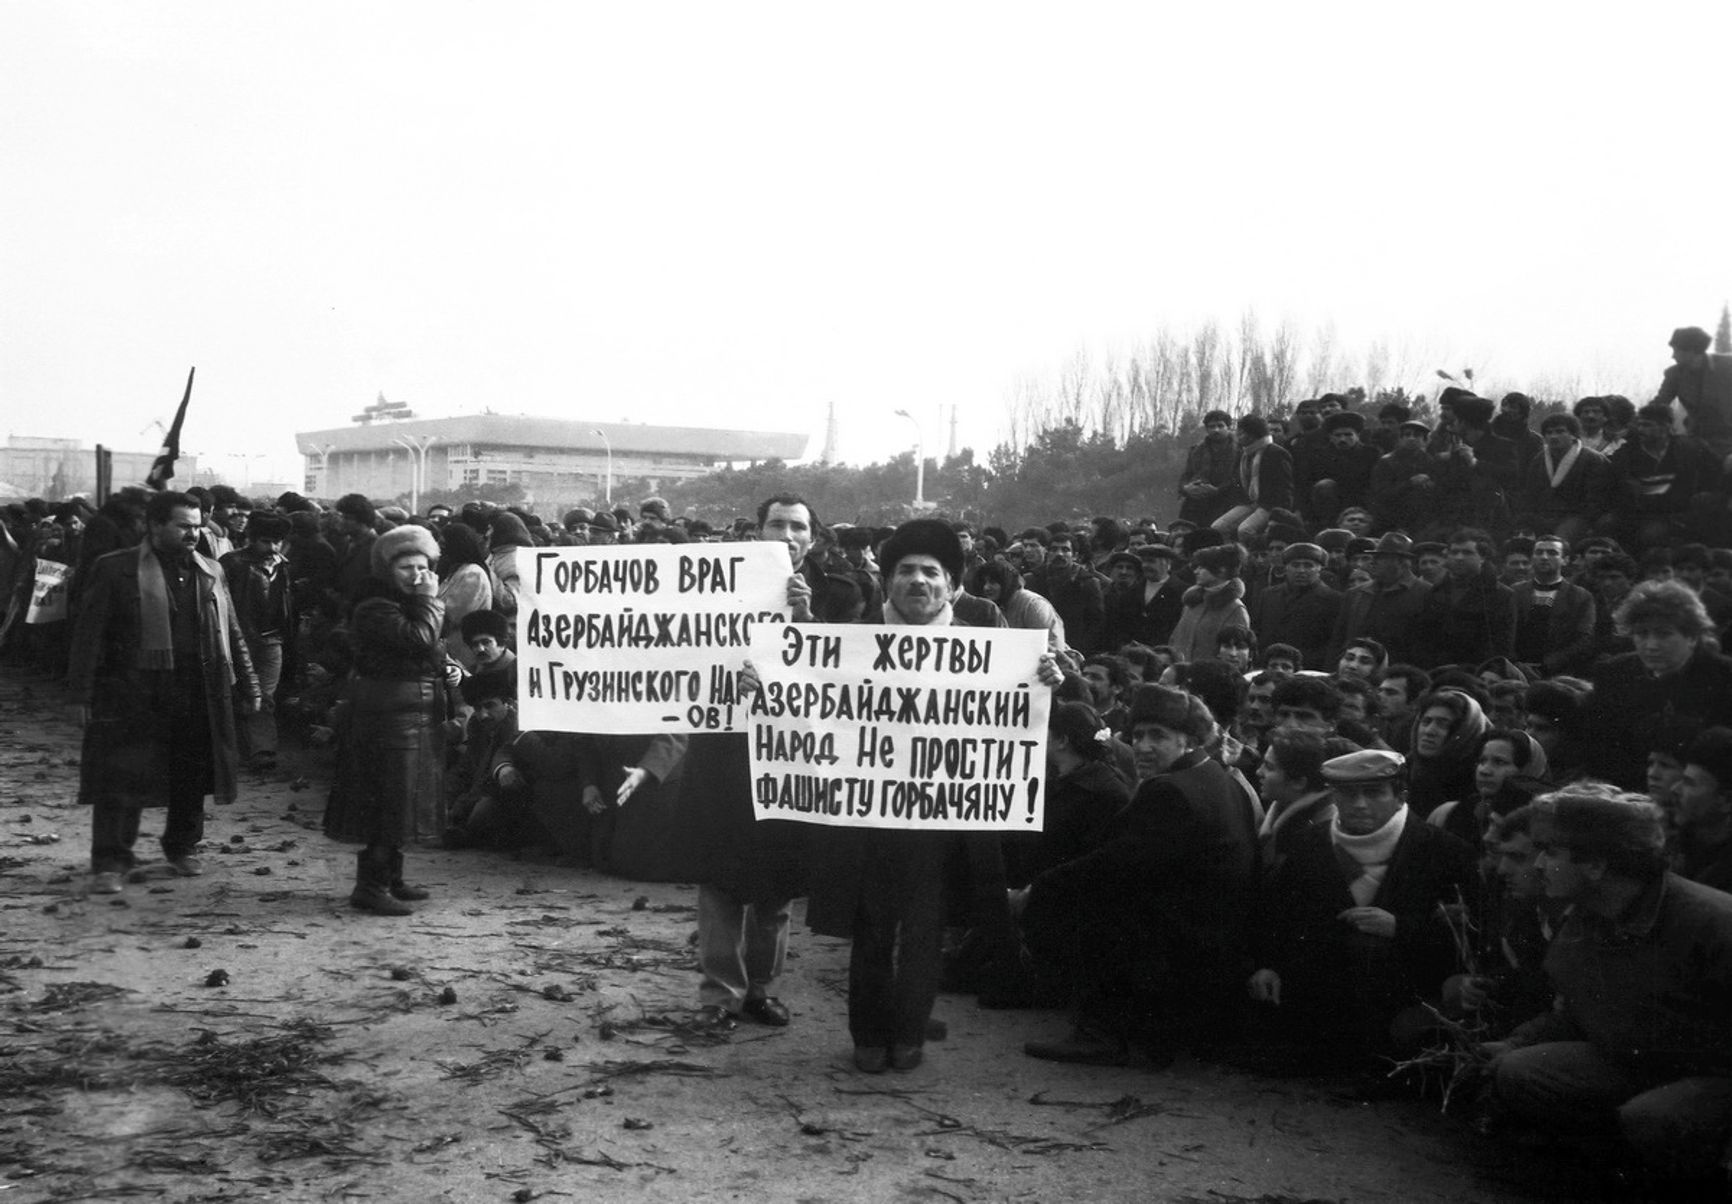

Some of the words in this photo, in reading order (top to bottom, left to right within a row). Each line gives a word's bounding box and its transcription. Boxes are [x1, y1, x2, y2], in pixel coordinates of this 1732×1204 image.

[535, 552, 660, 595] ГОРБАЧОВ
[678, 555, 745, 594] ВРАГ
[782, 625, 842, 668] ЭТИ
[548, 661, 701, 703] ГРУЗИНСКОГО
[755, 723, 840, 766] НАРОД
[909, 736, 1039, 781] ПРОСТИТ
[756, 772, 875, 818] ФАШИСТУ
